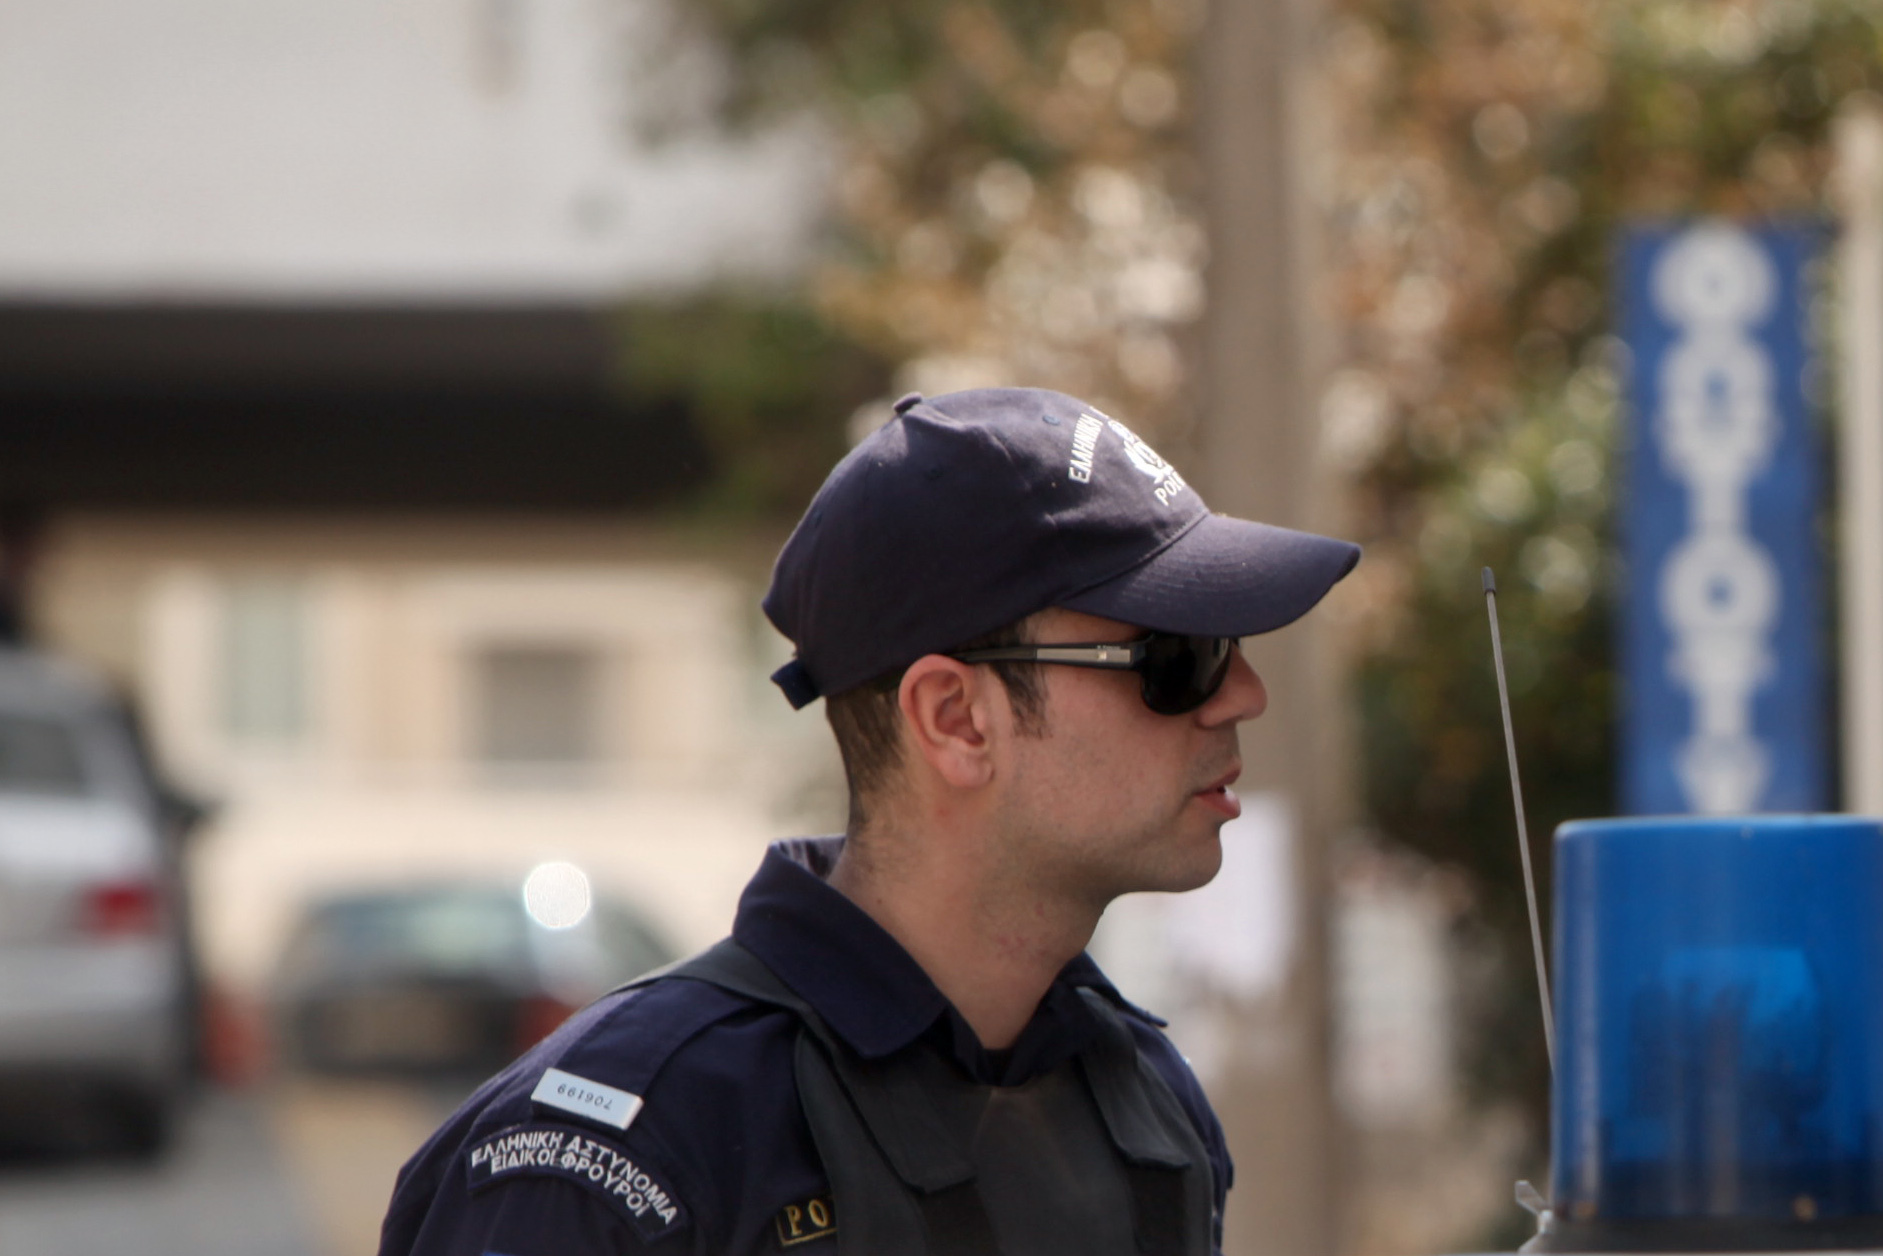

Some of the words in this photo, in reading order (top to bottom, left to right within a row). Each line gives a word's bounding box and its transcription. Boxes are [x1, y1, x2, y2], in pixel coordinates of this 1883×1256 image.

[470, 1130, 564, 1169] ΕΛΛΗΝΙΚΗ
[566, 1134, 679, 1226] ΑΣΤΥΝΟΜΙΑ
[490, 1149, 556, 1176] ΕΙΔΙΚΟΙ
[560, 1153, 651, 1218] ΦΡΟΥΡΟΙ
